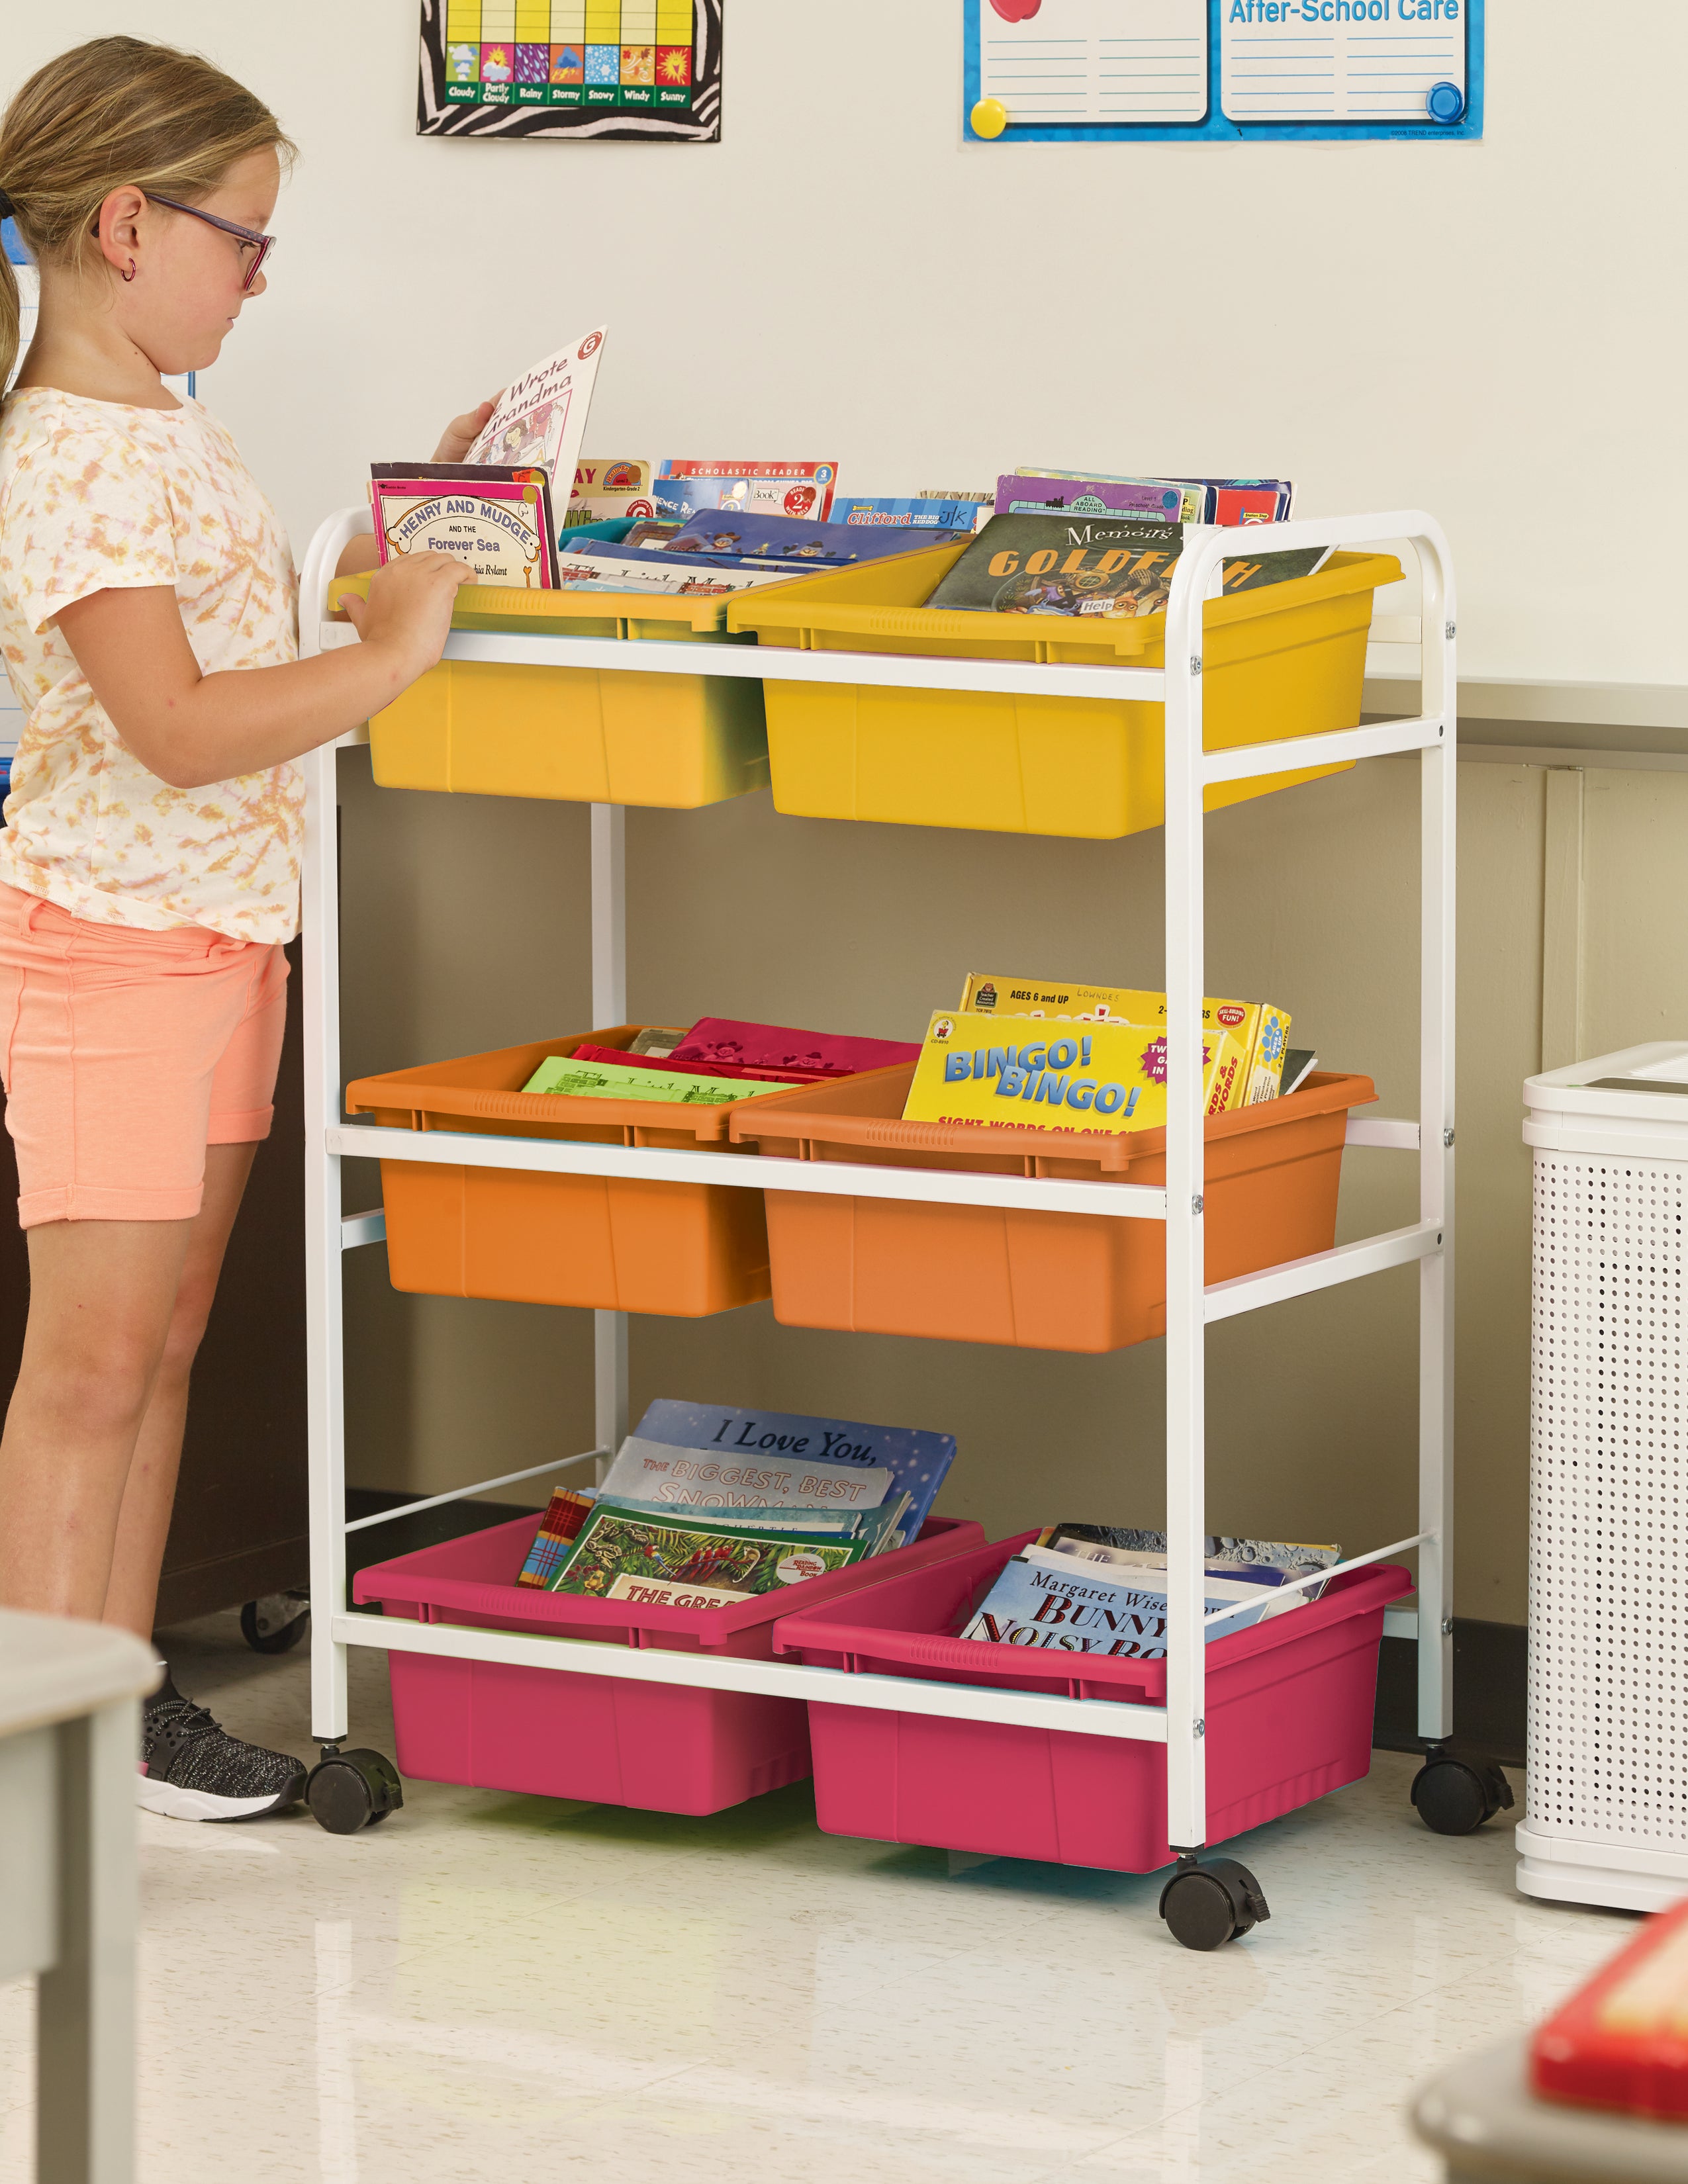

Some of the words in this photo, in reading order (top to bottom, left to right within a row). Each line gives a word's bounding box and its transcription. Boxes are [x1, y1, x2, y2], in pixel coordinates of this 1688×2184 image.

[1229, 0, 1389, 23] After-School
[1398, 0, 1459, 21] Care
[448, 86, 476, 99] Cloudy
[485, 83, 509, 94] Partly
[520, 87, 543, 100] Rainy
[552, 89, 581, 101] Stormy
[588, 89, 615, 101] Snowy
[624, 89, 650, 102] Windy
[483, 92, 510, 104] Cloudy
[660, 91, 686, 103] Sunny
[583, 337, 596, 354] G
[510, 358, 568, 402] Wrote
[481, 375, 572, 441] Grandma
[574, 468, 596, 484] AY
[821, 469, 827, 478] 3
[790, 486, 804, 495] READI
[657, 496, 679, 511] ENCE
[792, 493, 804, 509] 2
[786, 505, 796, 516] WITH
[798, 506, 809, 516] HELP
[399, 502, 441, 539] HENRY
[446, 500, 475, 513] AND
[480, 503, 532, 544] MUDGE
[847, 512, 912, 526] Clifford
[1065, 523, 1174, 546] Memoirs
[428, 537, 474, 551] Forever
[477, 538, 500, 552] Sea
[485, 566, 507, 576] Rylant
[1083, 601, 1113, 612] Help
[1009, 990, 1031, 1001] AGES
[1033, 992, 1039, 1001] 6
[1041, 994, 1055, 1003] and
[1057, 995, 1069, 1005] UP
[1077, 987, 1120, 1002] LOWNDES
[1158, 1005, 1168, 1015] 2-
[1150, 1045, 1168, 1054] TW
[945, 1035, 1093, 1083] BINGO!
[1152, 1066, 1164, 1075] IN
[994, 1065, 1143, 1117] BINGO!
[1207, 1082, 1222, 1115] RDS
[1219, 1065, 1228, 1079] &
[938, 1116, 984, 1126] SIGHT
[712, 1419, 733, 1443] I
[734, 1421, 810, 1453] Love
[819, 1432, 877, 1467] You,
[642, 1458, 671, 1473] THE
[671, 1460, 792, 1494] BIGGEST,
[798, 1476, 867, 1502] BEST
[651, 1482, 829, 1510] SNOW
[1074, 1549, 1112, 1563] THE
[626, 1585, 672, 1605] THE
[674, 1594, 736, 1609] GRE
[1029, 1570, 1117, 1603] Margaret
[1125, 1592, 1168, 1611] Wise
[964, 1612, 1103, 1653] NOISY
